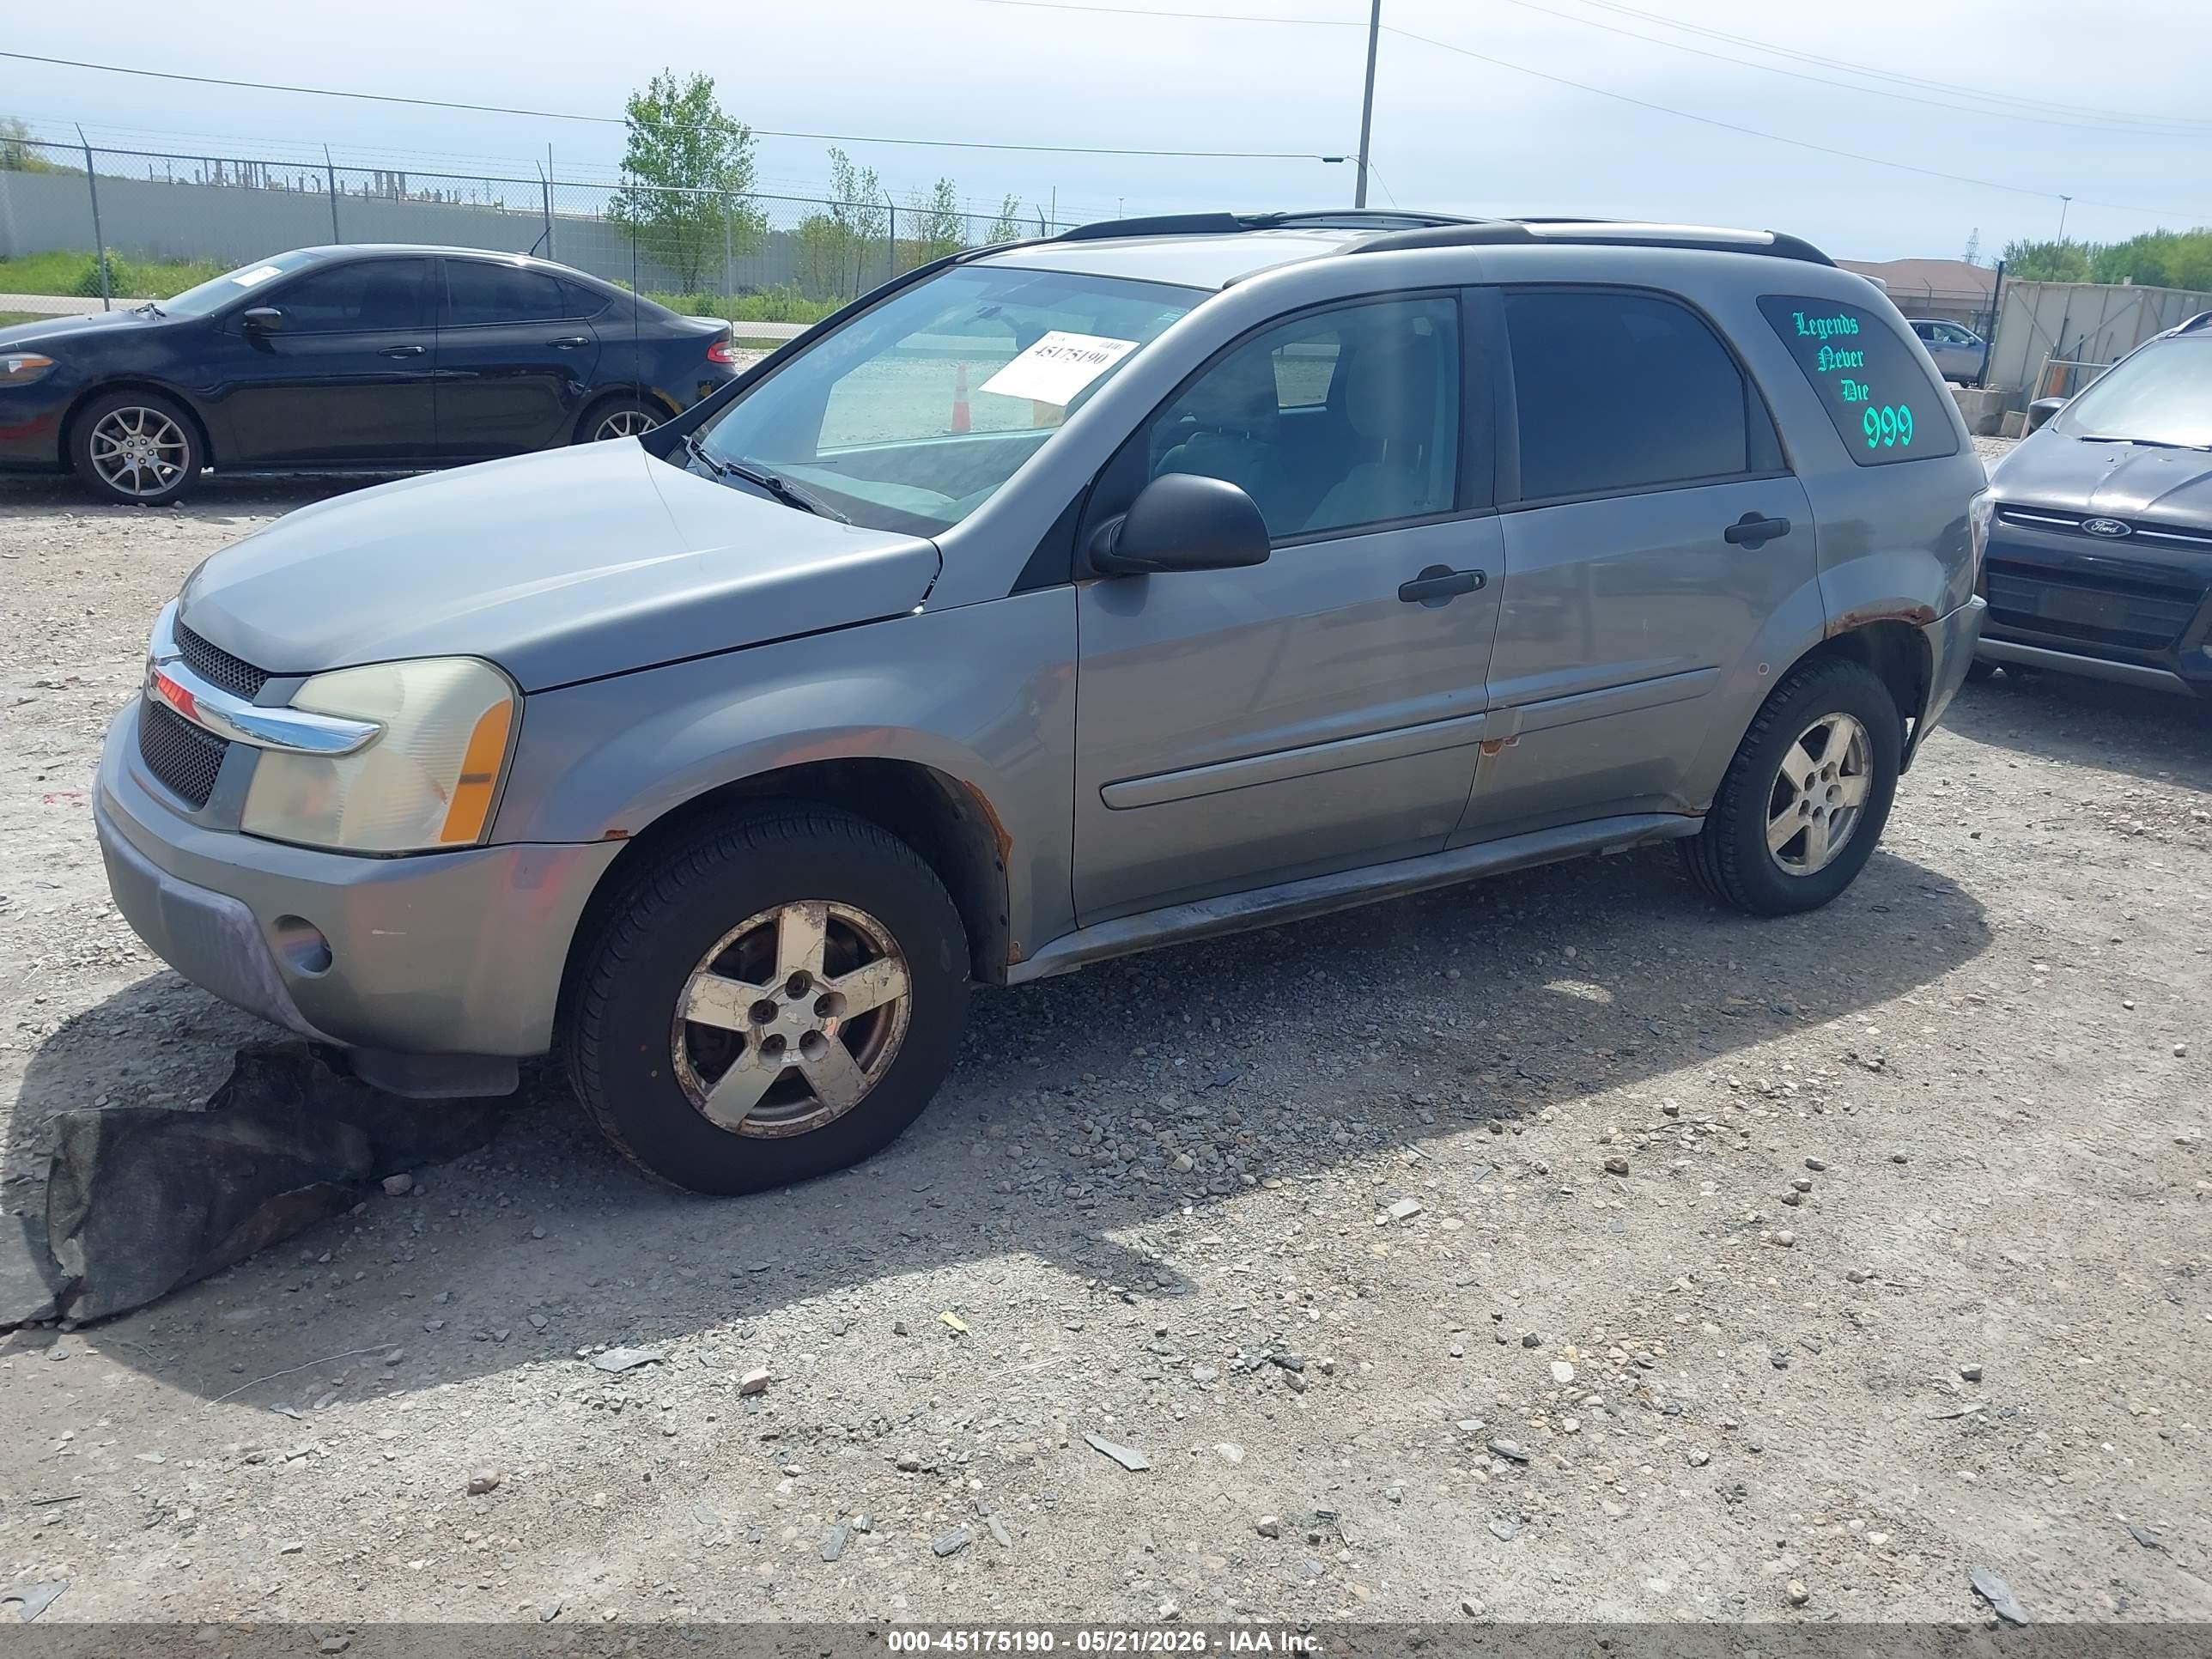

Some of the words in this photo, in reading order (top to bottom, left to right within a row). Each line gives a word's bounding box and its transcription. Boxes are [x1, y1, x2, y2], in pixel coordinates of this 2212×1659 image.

[1792, 312, 1860, 340] Legends
[1033, 345, 1109, 365] 45175190
[1817, 345, 1864, 372] Never
[1840, 379, 1869, 403] Die
[1862, 404, 1913, 449] 999
[2089, 520, 2119, 534] Ford
